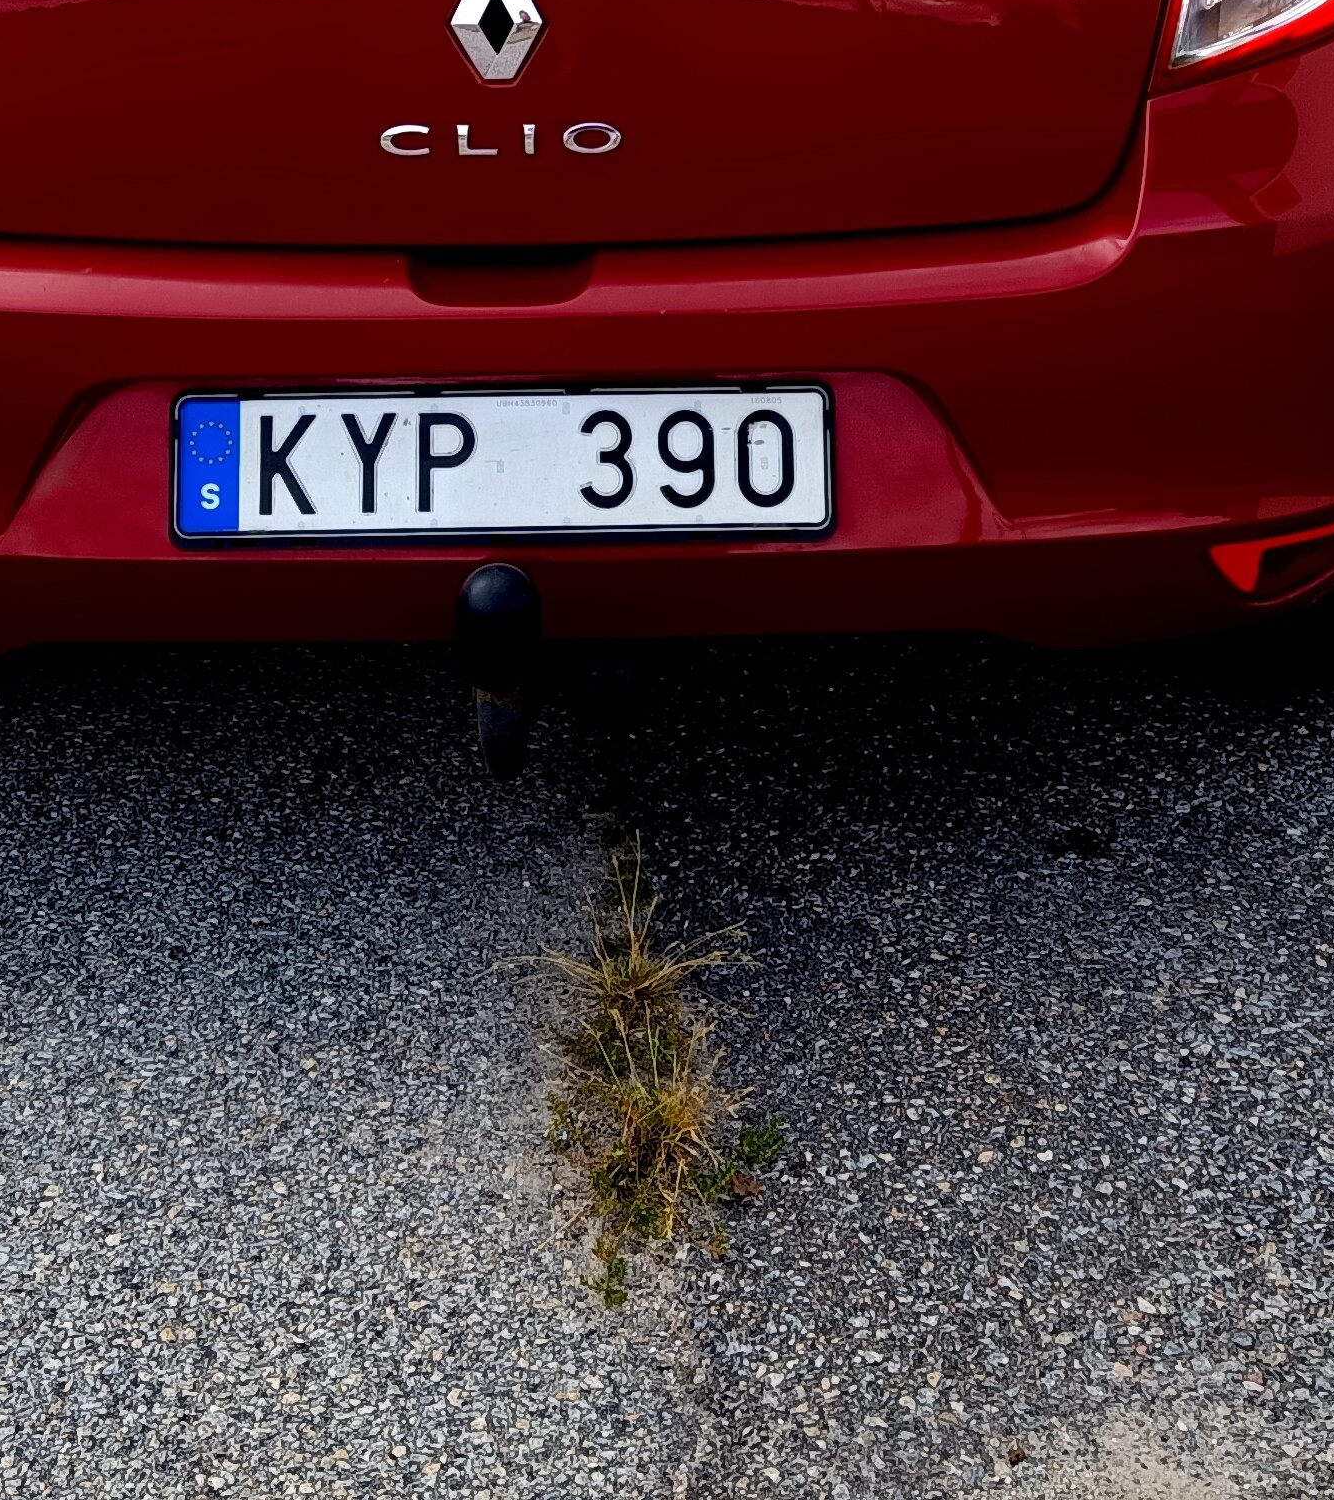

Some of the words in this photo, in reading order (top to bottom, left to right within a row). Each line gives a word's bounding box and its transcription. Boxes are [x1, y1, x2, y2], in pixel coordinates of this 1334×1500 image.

[380, 122, 622, 156] CLIO
[259, 412, 477, 516] KYP
[579, 409, 795, 509] 390
[200, 483, 221, 510] S
